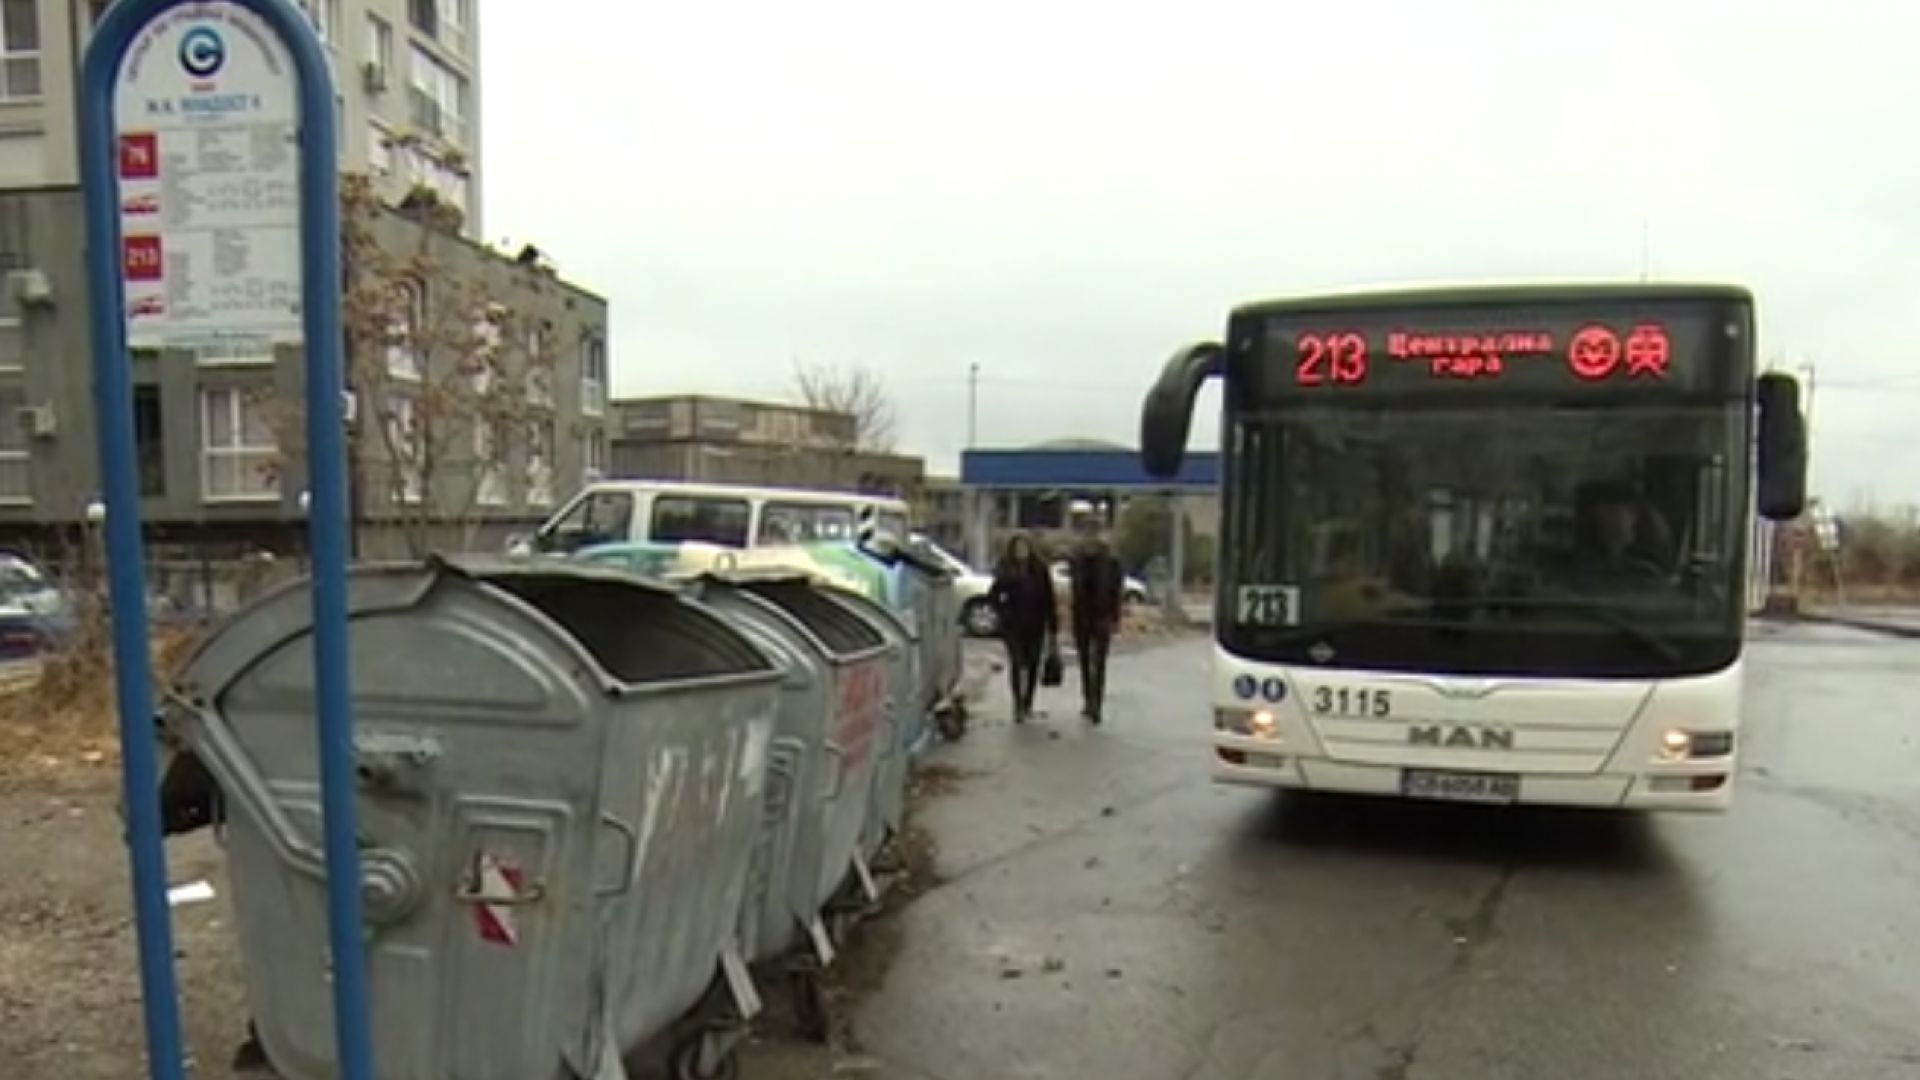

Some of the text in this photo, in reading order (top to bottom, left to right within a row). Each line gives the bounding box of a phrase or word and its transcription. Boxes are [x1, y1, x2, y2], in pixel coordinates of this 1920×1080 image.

[1296, 332, 1365, 384] 213
[1387, 332, 1551, 358] Централна
[1432, 357, 1502, 377] гара
[1246, 589, 1288, 626] 213
[1315, 686, 1391, 717] 3115
[1407, 724, 1513, 749] MAN
